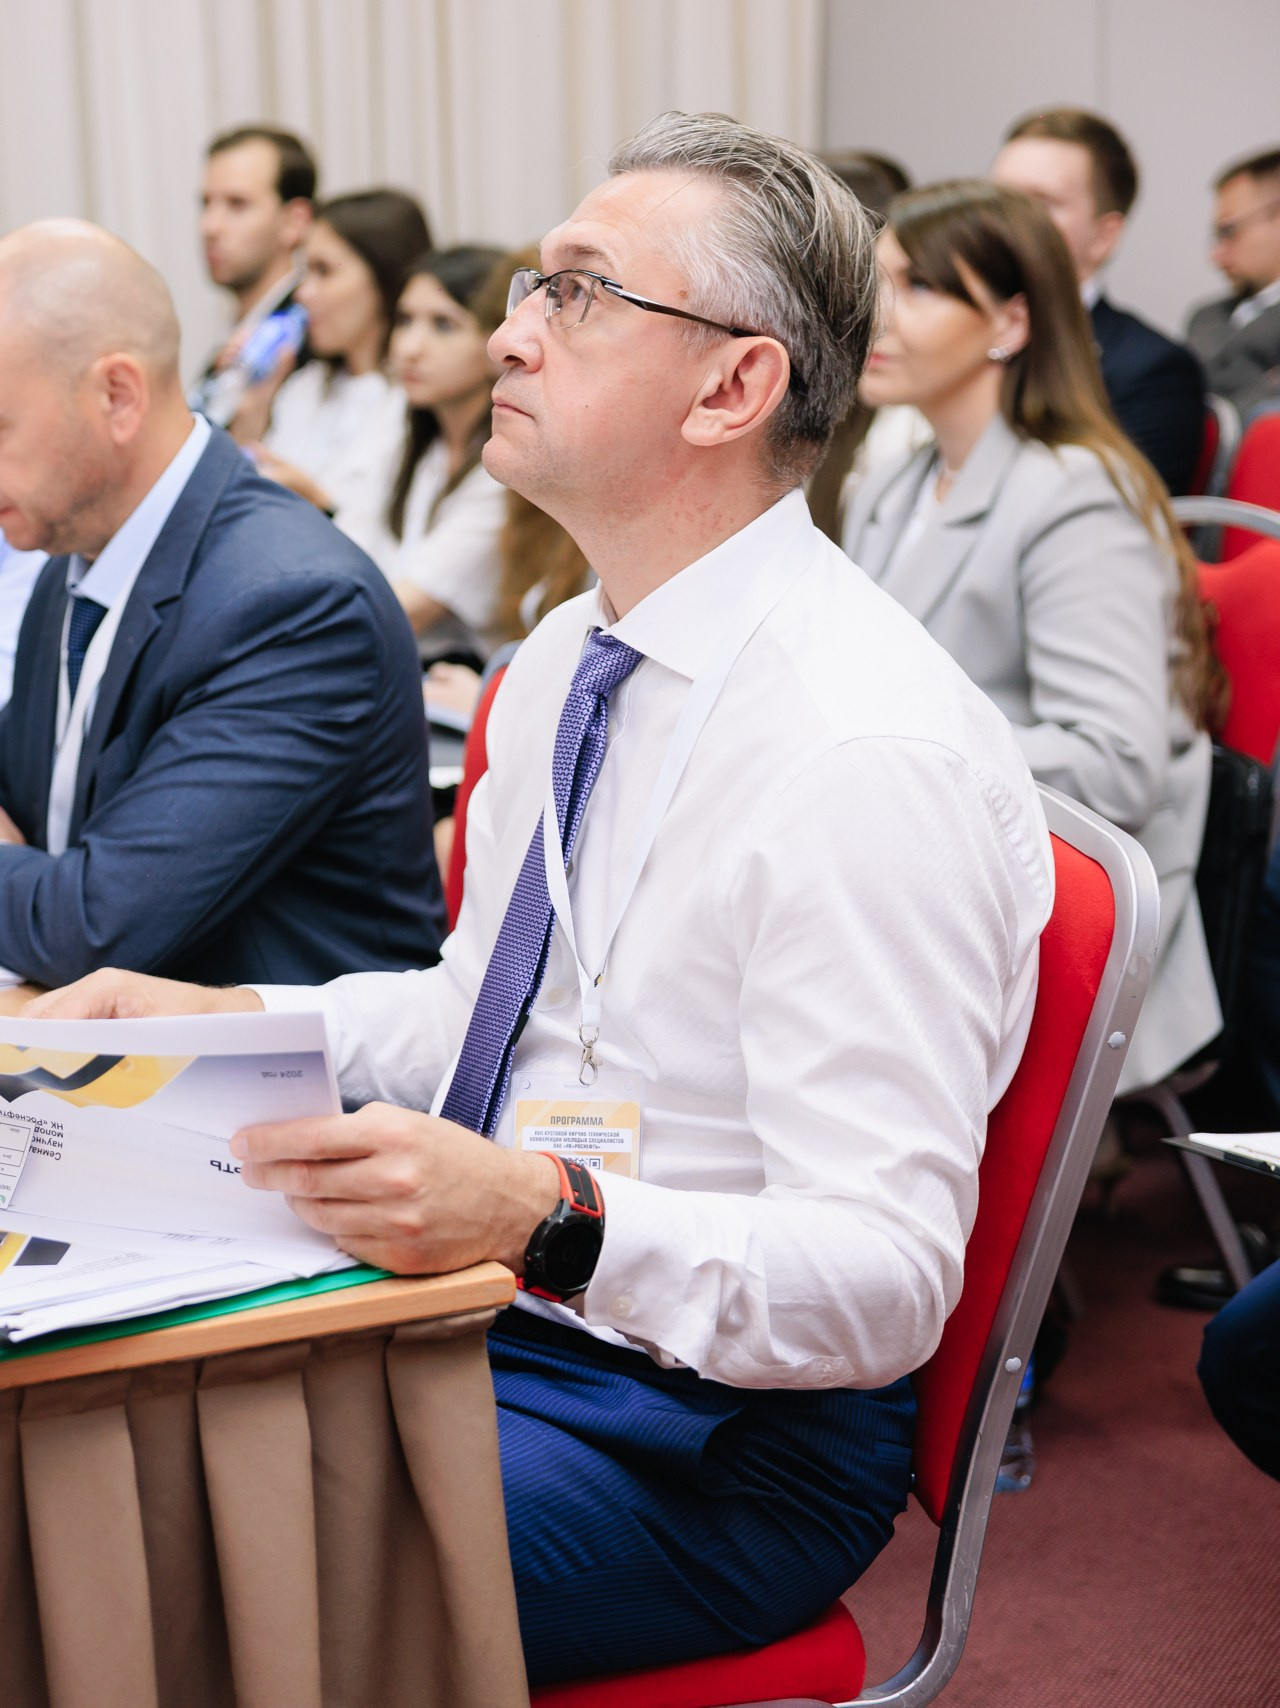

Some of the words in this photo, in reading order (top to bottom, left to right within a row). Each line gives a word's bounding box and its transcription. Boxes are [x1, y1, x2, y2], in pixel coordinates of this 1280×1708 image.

[280, 1070, 303, 1078] 2024
[50, 1120, 64, 1130] НК
[550, 1116, 604, 1126] ПРОГРАММА
